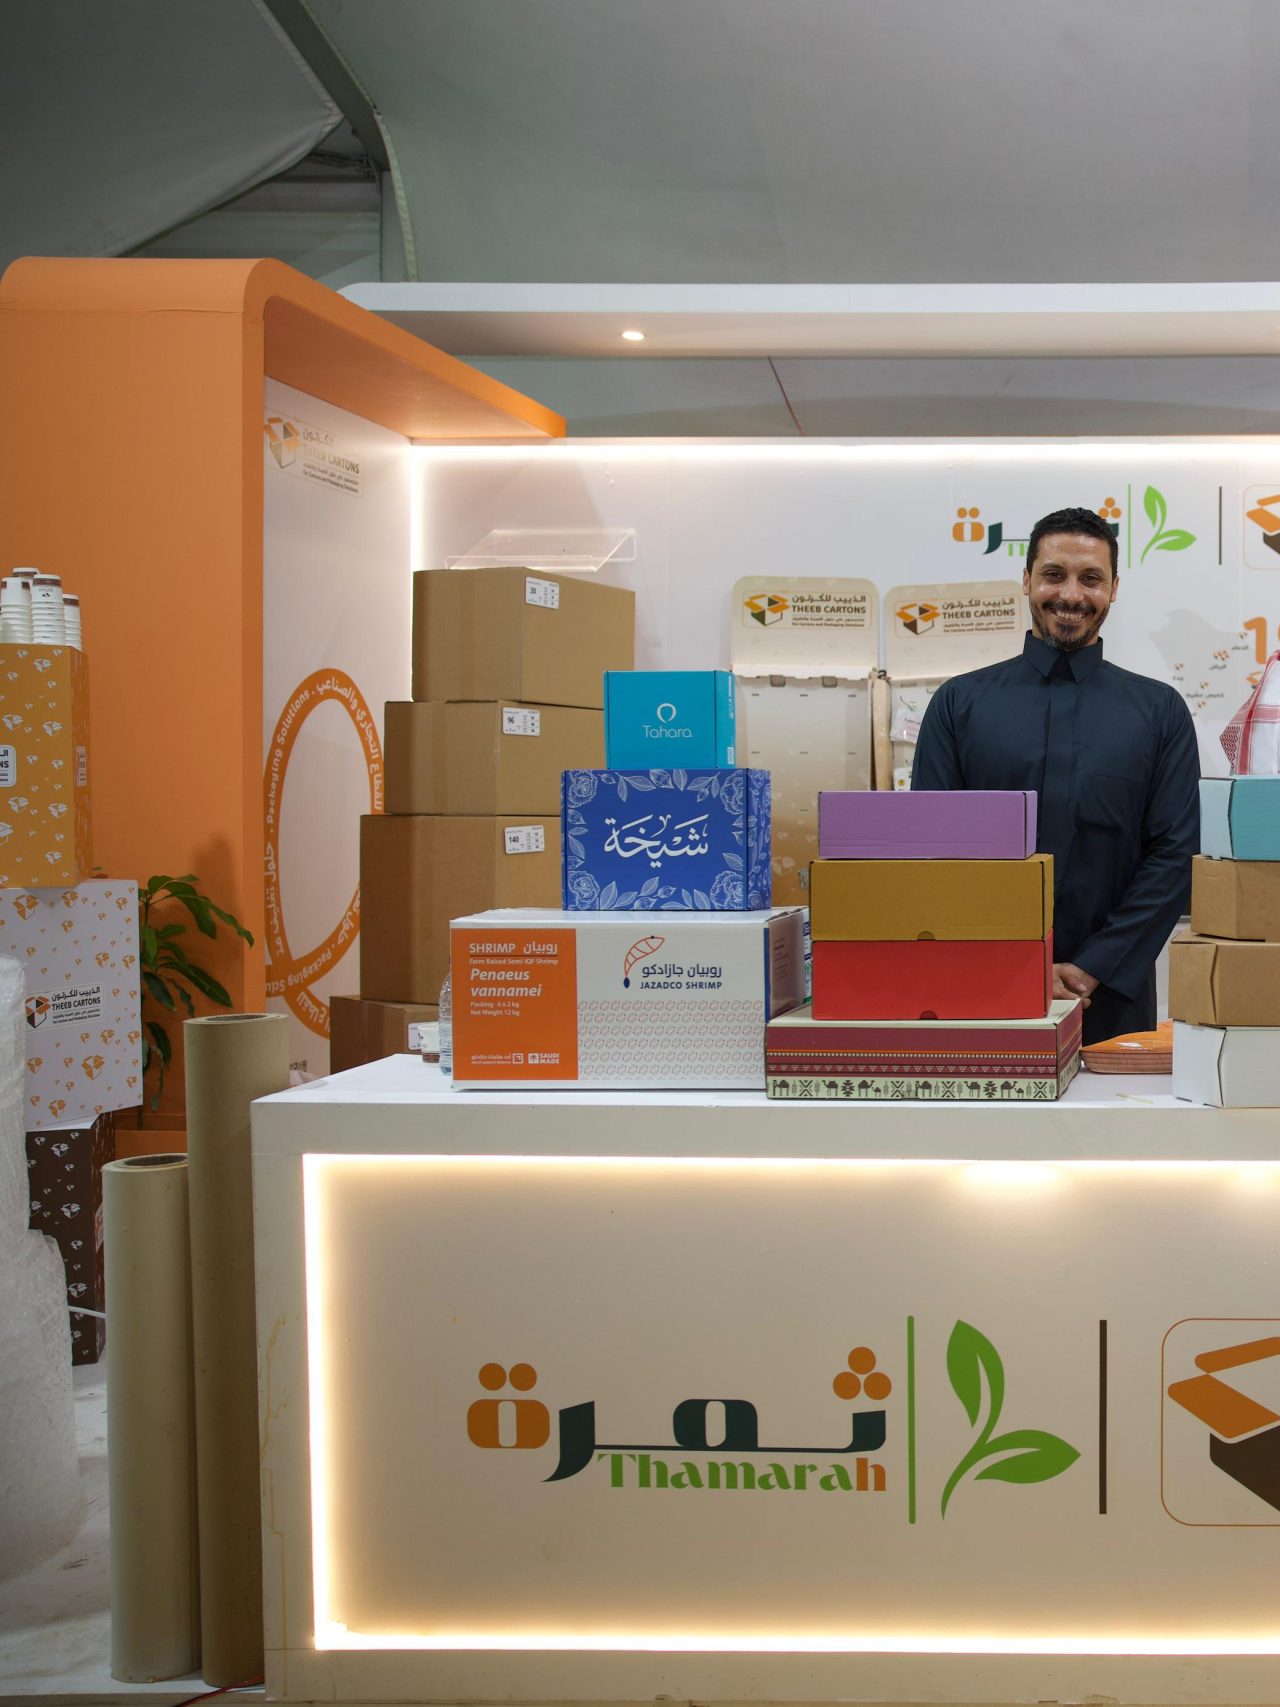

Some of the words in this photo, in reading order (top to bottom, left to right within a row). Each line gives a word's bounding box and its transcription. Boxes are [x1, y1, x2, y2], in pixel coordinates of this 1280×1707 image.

[329, 454, 359, 474] CARTONS
[792, 605, 821, 613] THEEB
[824, 606, 866, 614] CARTONS
[943, 611, 971, 619] THEEB
[974, 609, 1015, 618] CARTONS
[642, 725, 693, 738] Tahara
[267, 750, 283, 824] Packaging
[277, 689, 310, 745] Solutions
[469, 943, 515, 953] SHRIMP
[523, 941, 557, 954] روبيان
[536, 958, 559, 966] Shrimp
[471, 968, 530, 980] Penaeus
[642, 963, 683, 978] جازادكو
[687, 963, 722, 978] روبيان
[471, 984, 542, 996] vannamei
[52, 1002, 72, 1011] THEEB
[73, 997, 100, 1007] CARTONS
[597, 1453, 887, 1492] Thamarah
